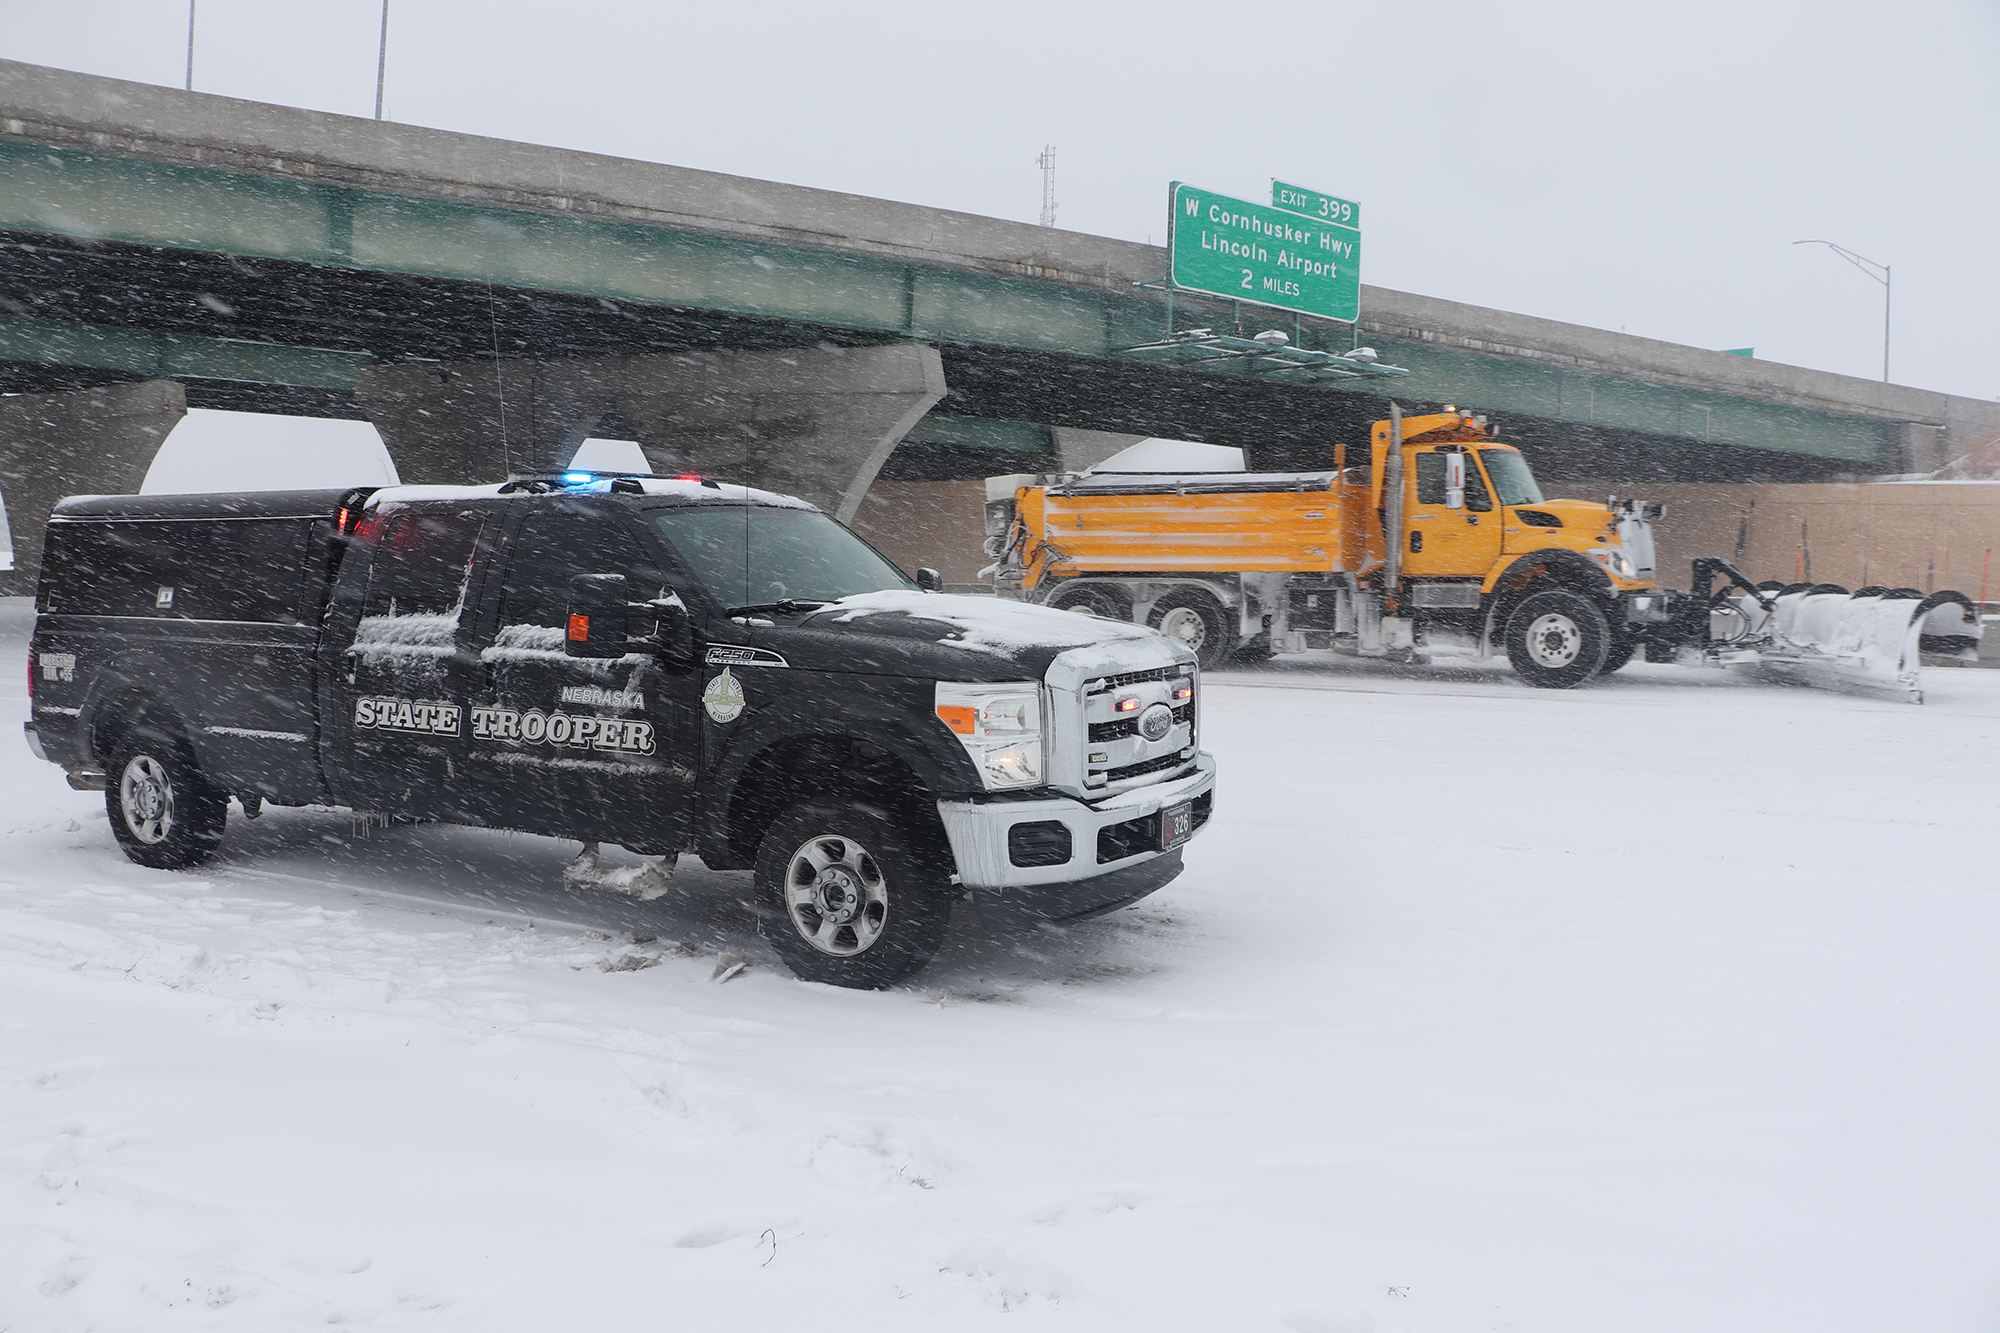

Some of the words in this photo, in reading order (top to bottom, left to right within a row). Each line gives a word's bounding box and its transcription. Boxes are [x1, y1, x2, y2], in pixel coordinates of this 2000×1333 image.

[1280, 189, 1307, 208] EXIT
[1318, 197, 1351, 222] 399
[1185, 197, 1199, 217] W
[1209, 204, 1311, 244] Cornhusker
[1320, 232, 1352, 259] Hwy
[1201, 230, 1267, 262] Lincoln
[1277, 249, 1337, 279] Airport
[1241, 268, 1253, 289] 2
[1263, 276, 1300, 296] MILES
[561, 686, 645, 710] NEBRASKA
[707, 679, 720, 692] STATE
[355, 698, 462, 738] STATE
[471, 706, 656, 756] TROOPER
[711, 710, 735, 721] NEBRASKA
[1174, 813, 1189, 836] 326
